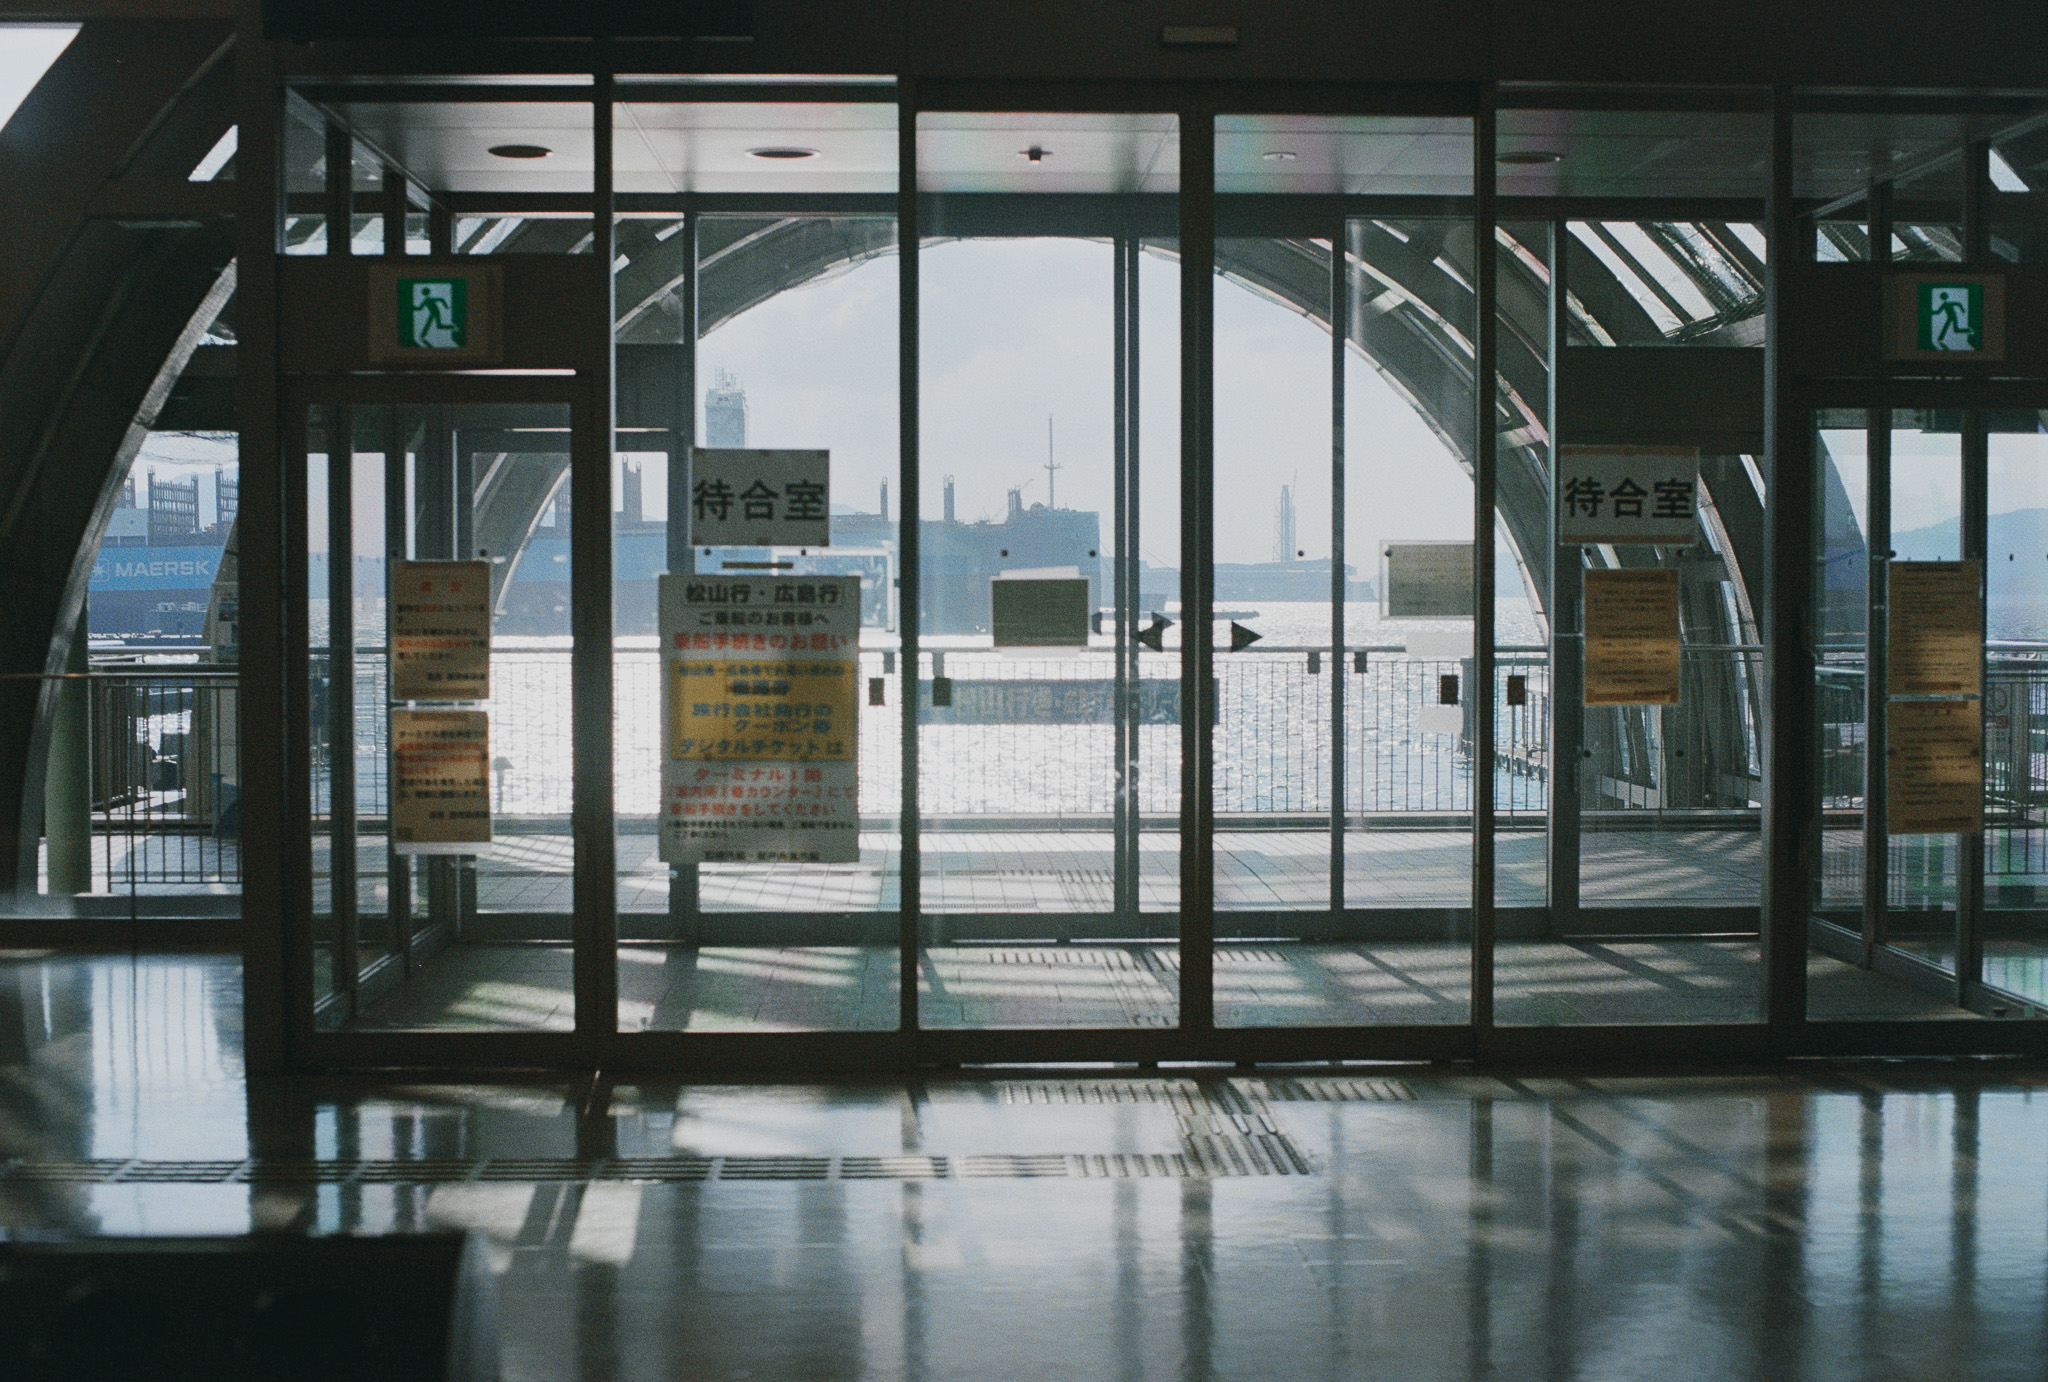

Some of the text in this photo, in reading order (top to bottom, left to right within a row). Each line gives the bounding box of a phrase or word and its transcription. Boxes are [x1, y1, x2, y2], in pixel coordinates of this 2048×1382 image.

[692, 479, 826, 521] 待合室
[1564, 476, 1693, 518] 待合室
[115, 560, 210, 577] MAERSK
